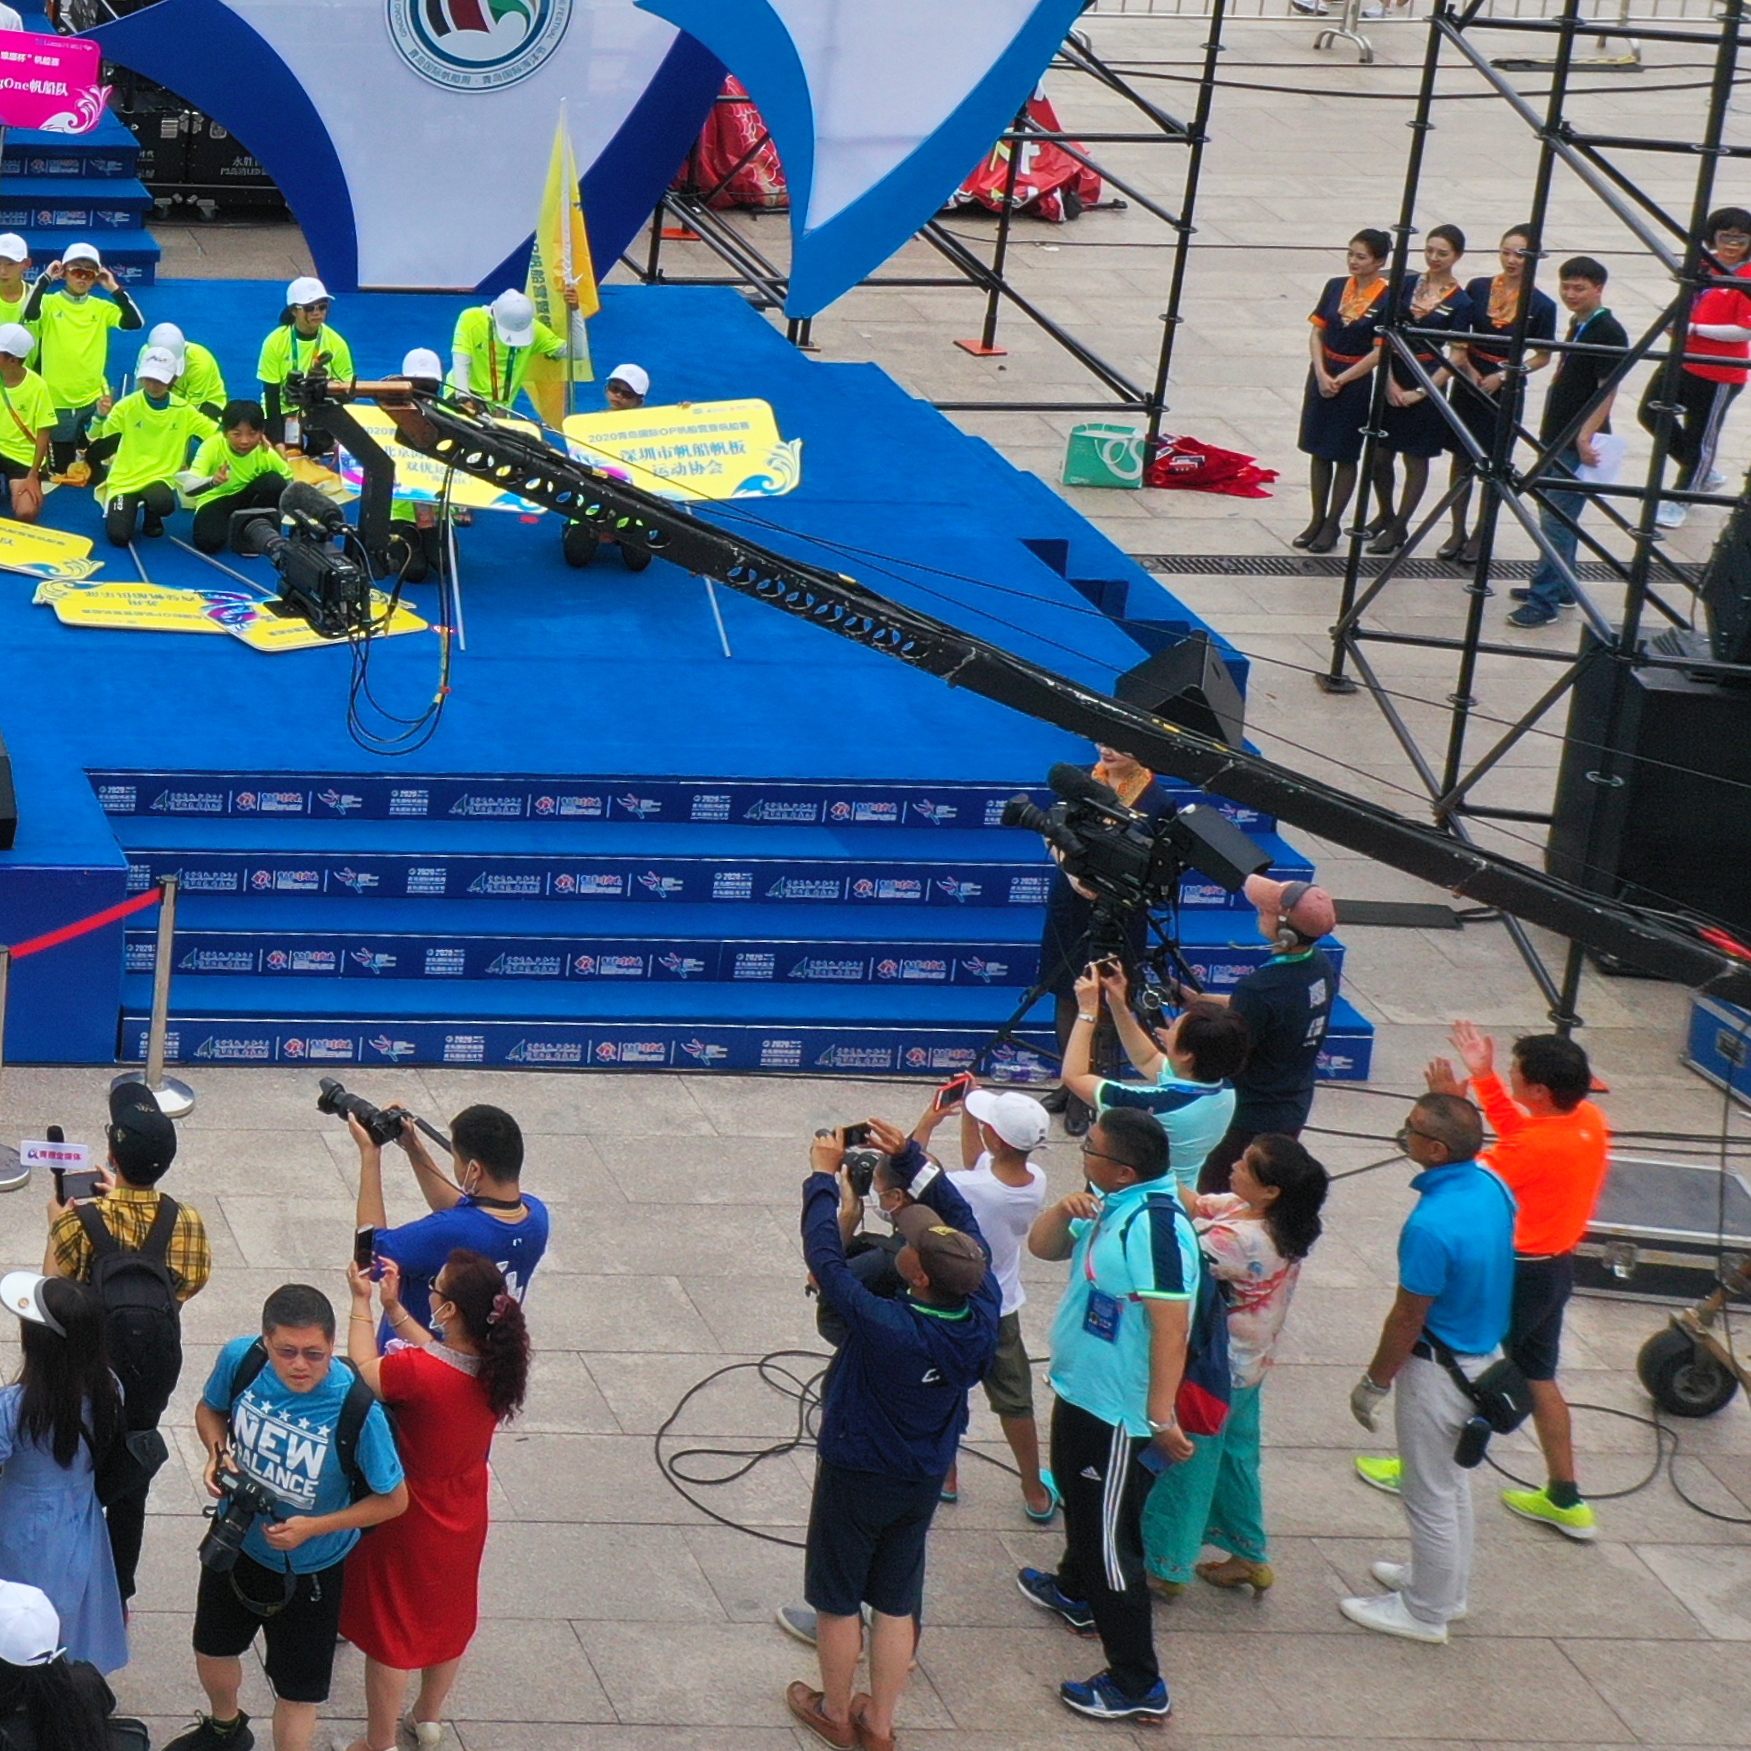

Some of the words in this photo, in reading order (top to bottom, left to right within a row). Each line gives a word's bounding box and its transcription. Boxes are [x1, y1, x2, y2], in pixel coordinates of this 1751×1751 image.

[620, 439, 748, 465] 深圳市帆船帆板
[233, 1405, 329, 1476] NEW
